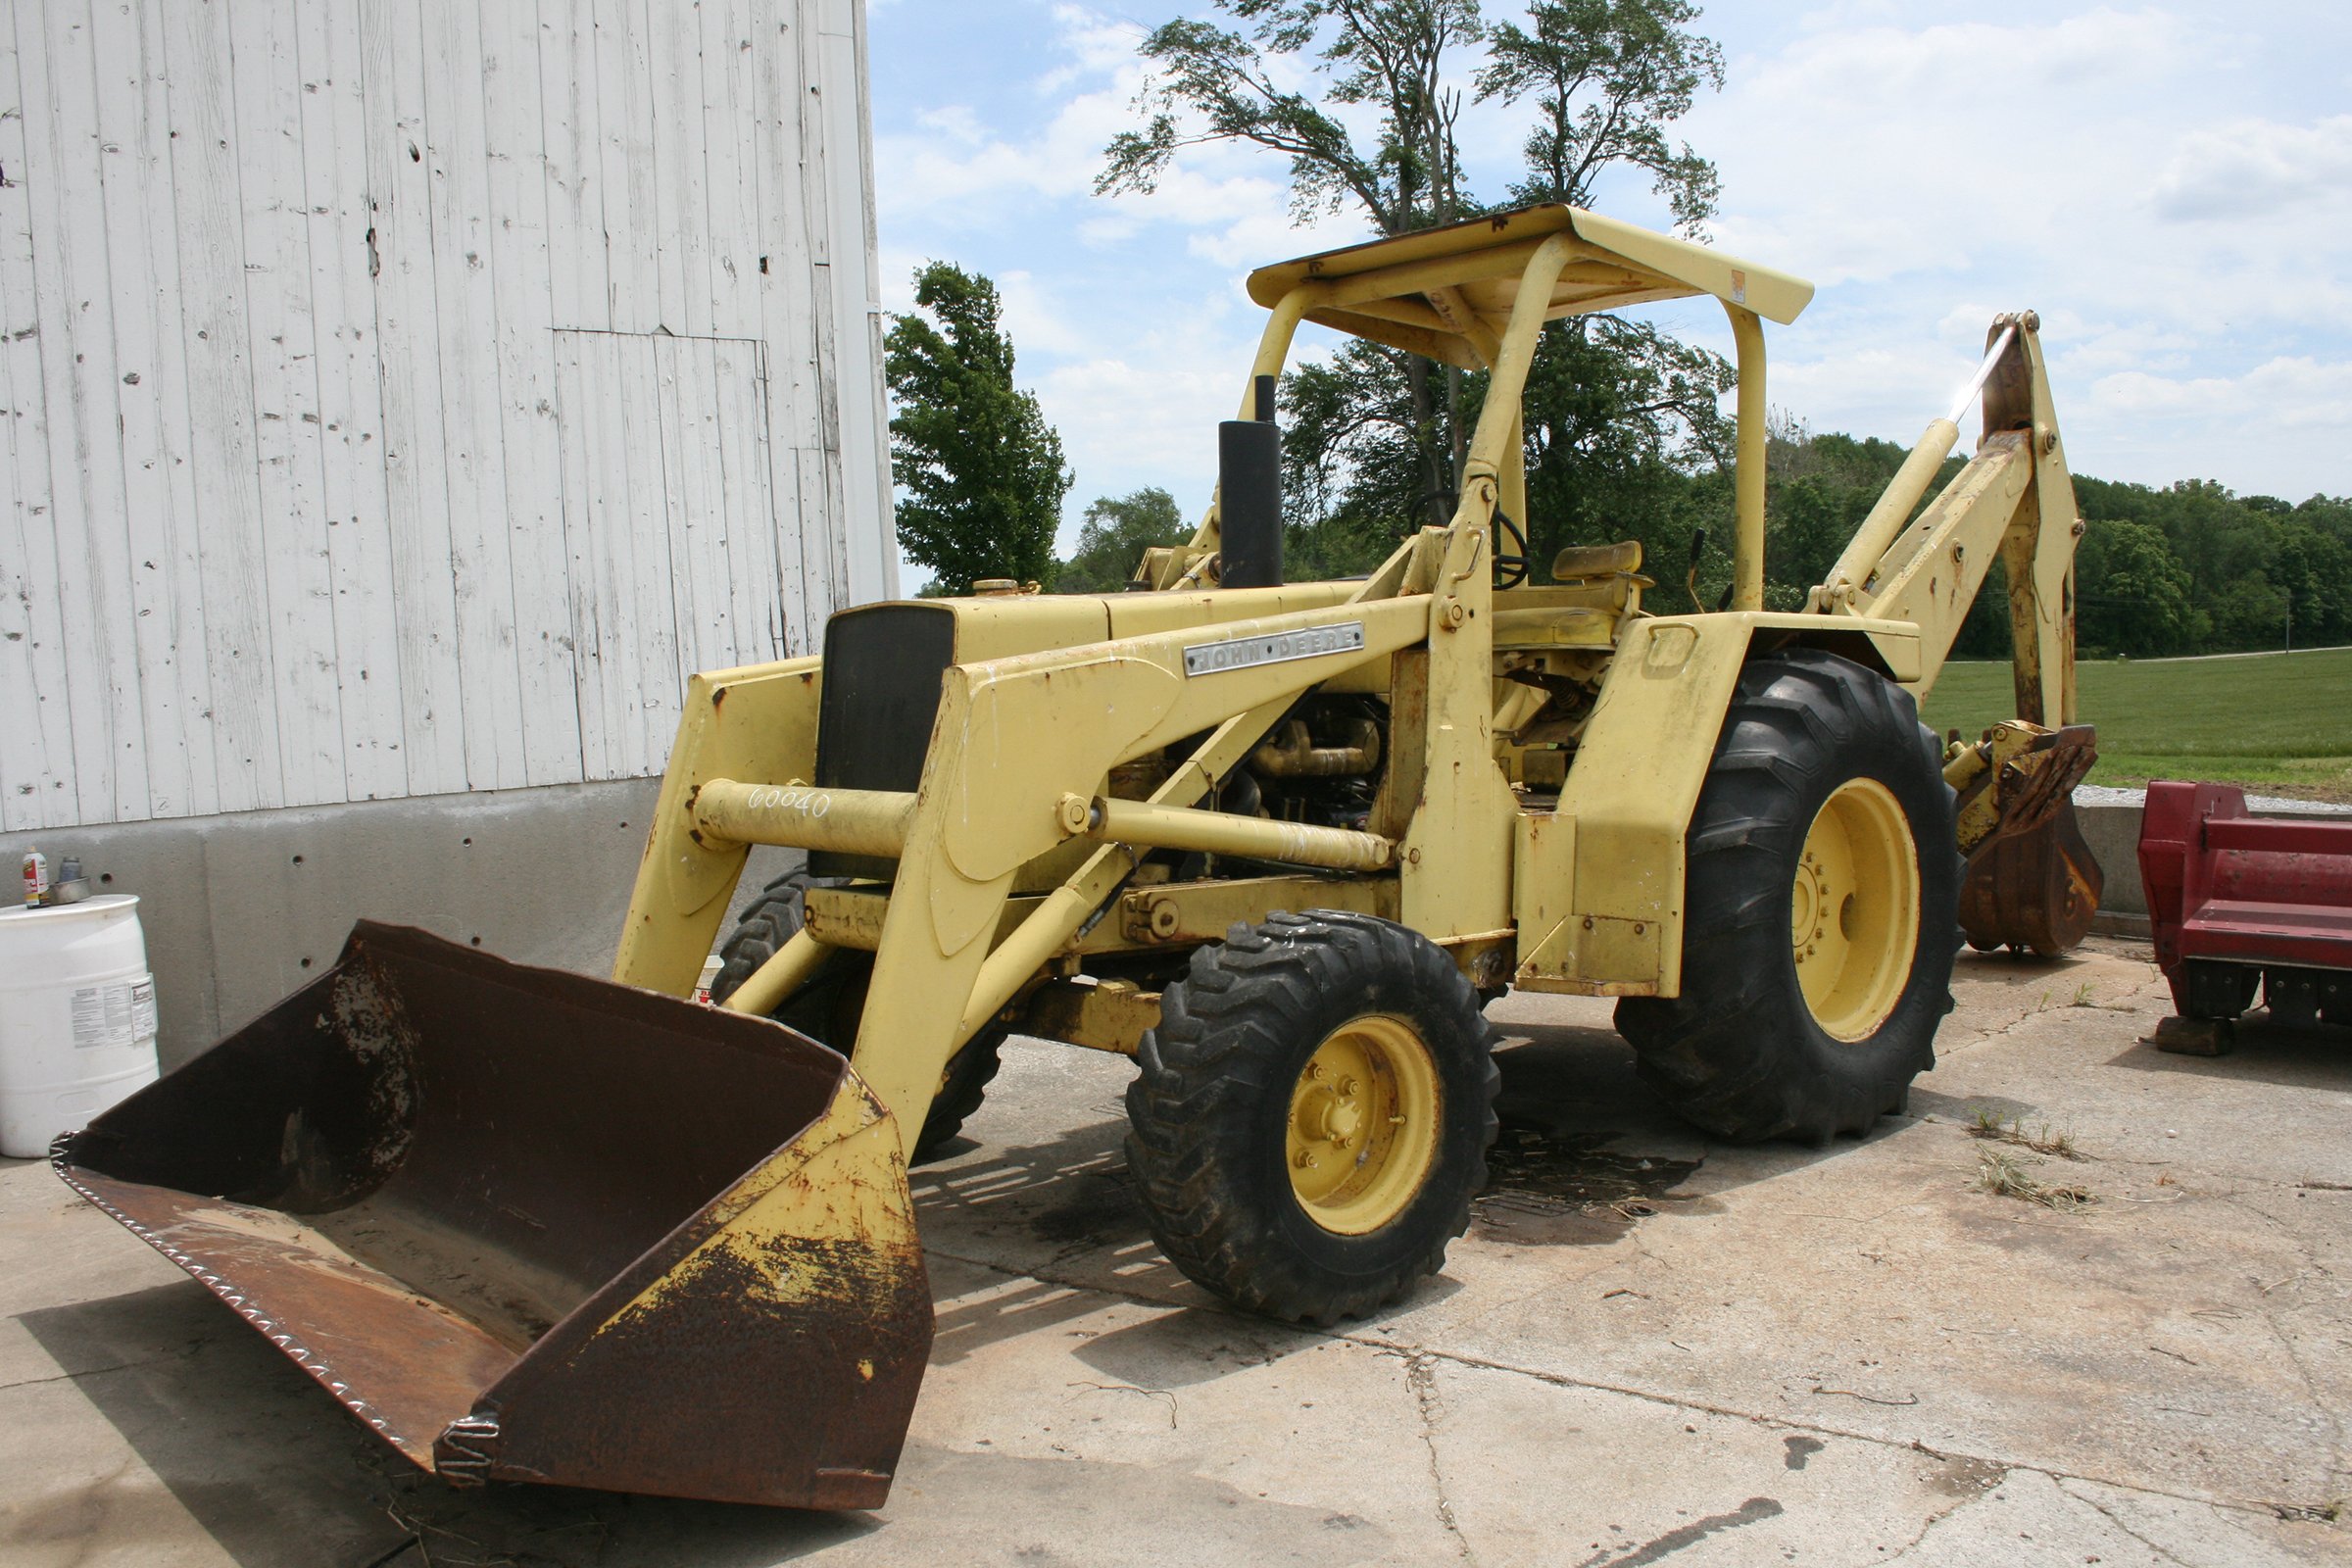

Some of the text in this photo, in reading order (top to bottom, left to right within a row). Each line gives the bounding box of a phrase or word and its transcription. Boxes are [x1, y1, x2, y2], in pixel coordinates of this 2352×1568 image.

[1197, 628, 1354, 670] JOHN DEERE
[748, 787, 830, 818] 60040
